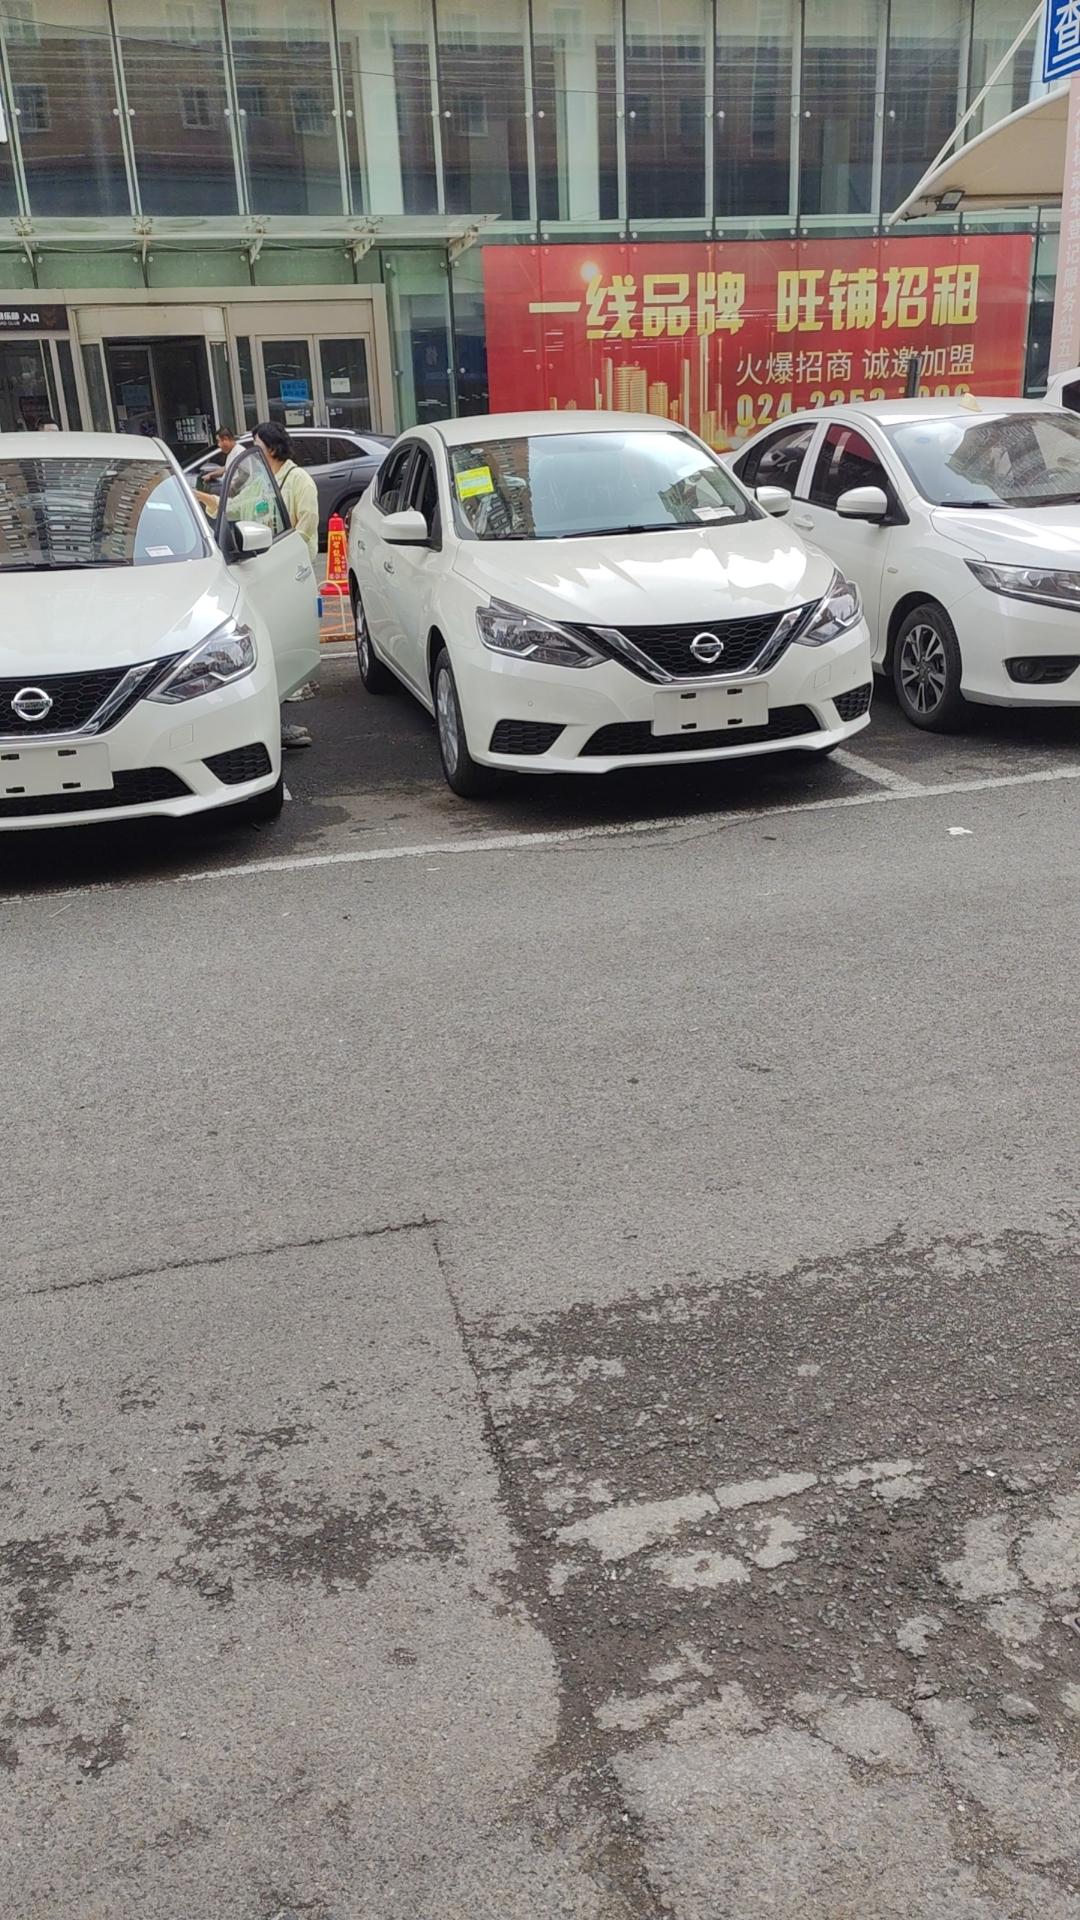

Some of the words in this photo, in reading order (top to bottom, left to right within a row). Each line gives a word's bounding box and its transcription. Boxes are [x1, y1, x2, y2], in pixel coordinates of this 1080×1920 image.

[1052, 0, 1080, 64] 查
[22, 312, 40, 323] 入口
[529, 271, 745, 339] 一线品牌
[776, 264, 980, 333] 旺铺招租
[736, 348, 854, 386] 火爆招商
[862, 343, 975, 381] 诚邀加盟
